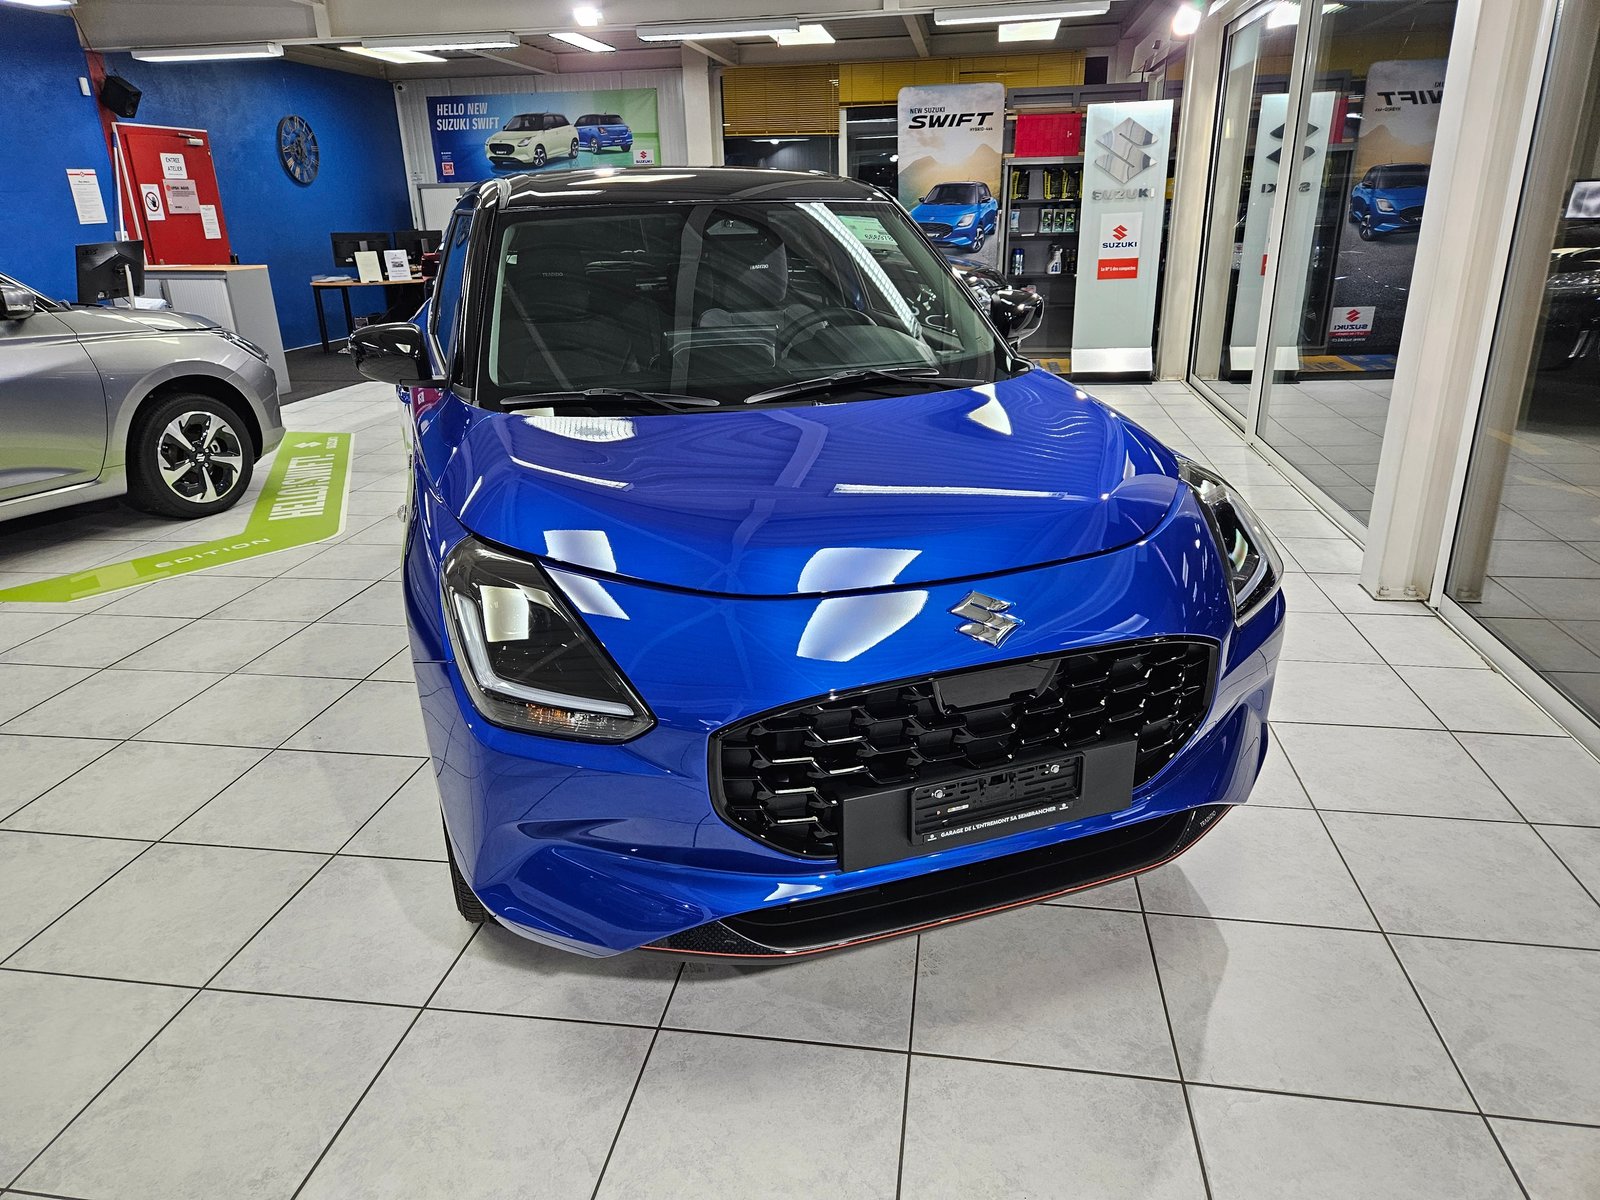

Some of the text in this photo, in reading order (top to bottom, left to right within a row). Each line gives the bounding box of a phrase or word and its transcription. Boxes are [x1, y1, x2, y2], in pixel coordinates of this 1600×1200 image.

[437, 102, 488, 116] HELLO NEW
[436, 117, 500, 131] SUZUKI SWIFT
[908, 112, 994, 130] SWIFT
[1092, 188, 1155, 201] SUZUKI
[1102, 241, 1138, 249] SUZUKI
[154, 537, 271, 569] EDITION
[940, 827, 964, 838] GARAGE
[972, 817, 1010, 830] L'ENTREMONT
[1018, 806, 1057, 820] SEMBRANCHER
